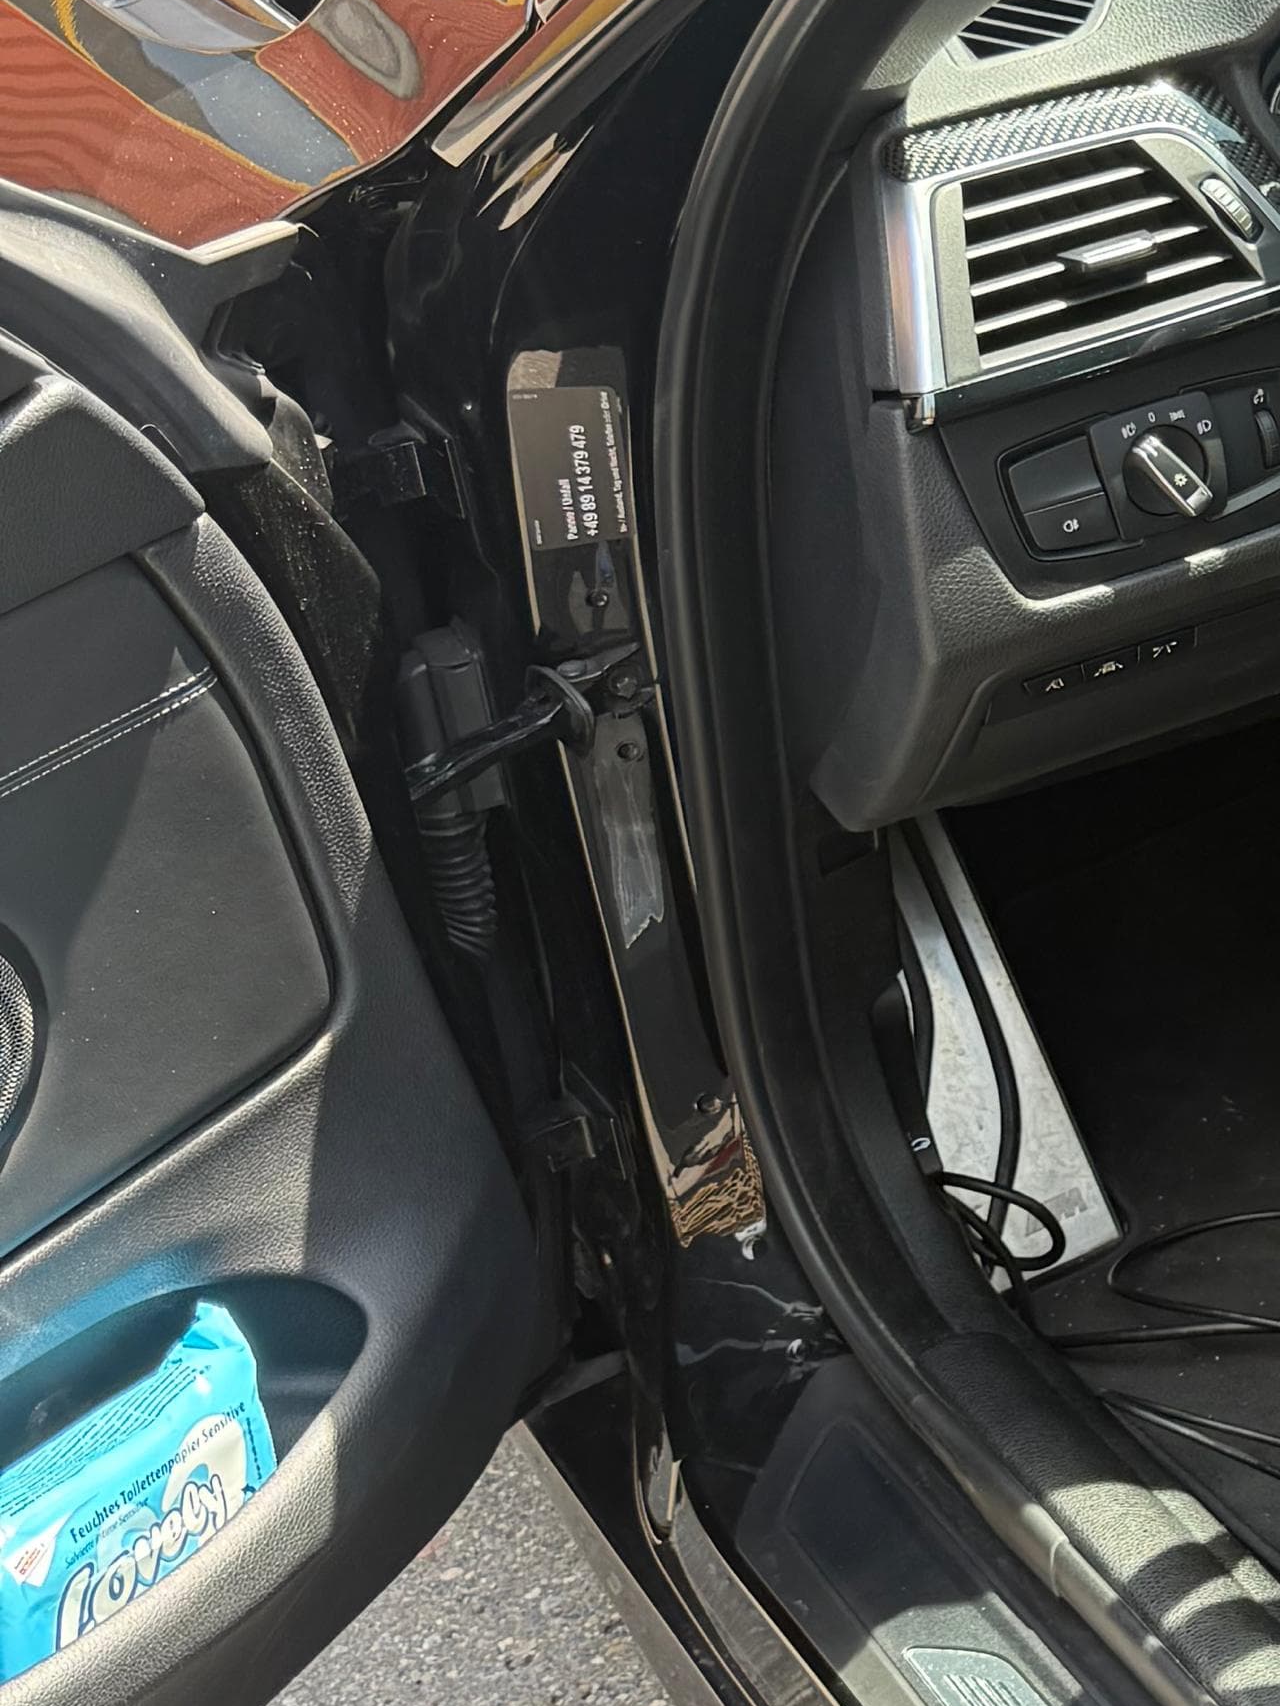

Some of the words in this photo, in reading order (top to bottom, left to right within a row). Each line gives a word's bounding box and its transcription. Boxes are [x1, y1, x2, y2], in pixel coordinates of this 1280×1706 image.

[569, 424, 587, 449] 479
[573, 450, 591, 475] 379
[576, 475, 593, 492] 14
[579, 493, 595, 511] 89
[582, 512, 599, 537] +49
[69, 1498, 121, 1544] Feuchtes
[201, 1401, 247, 1443] Sensitive
